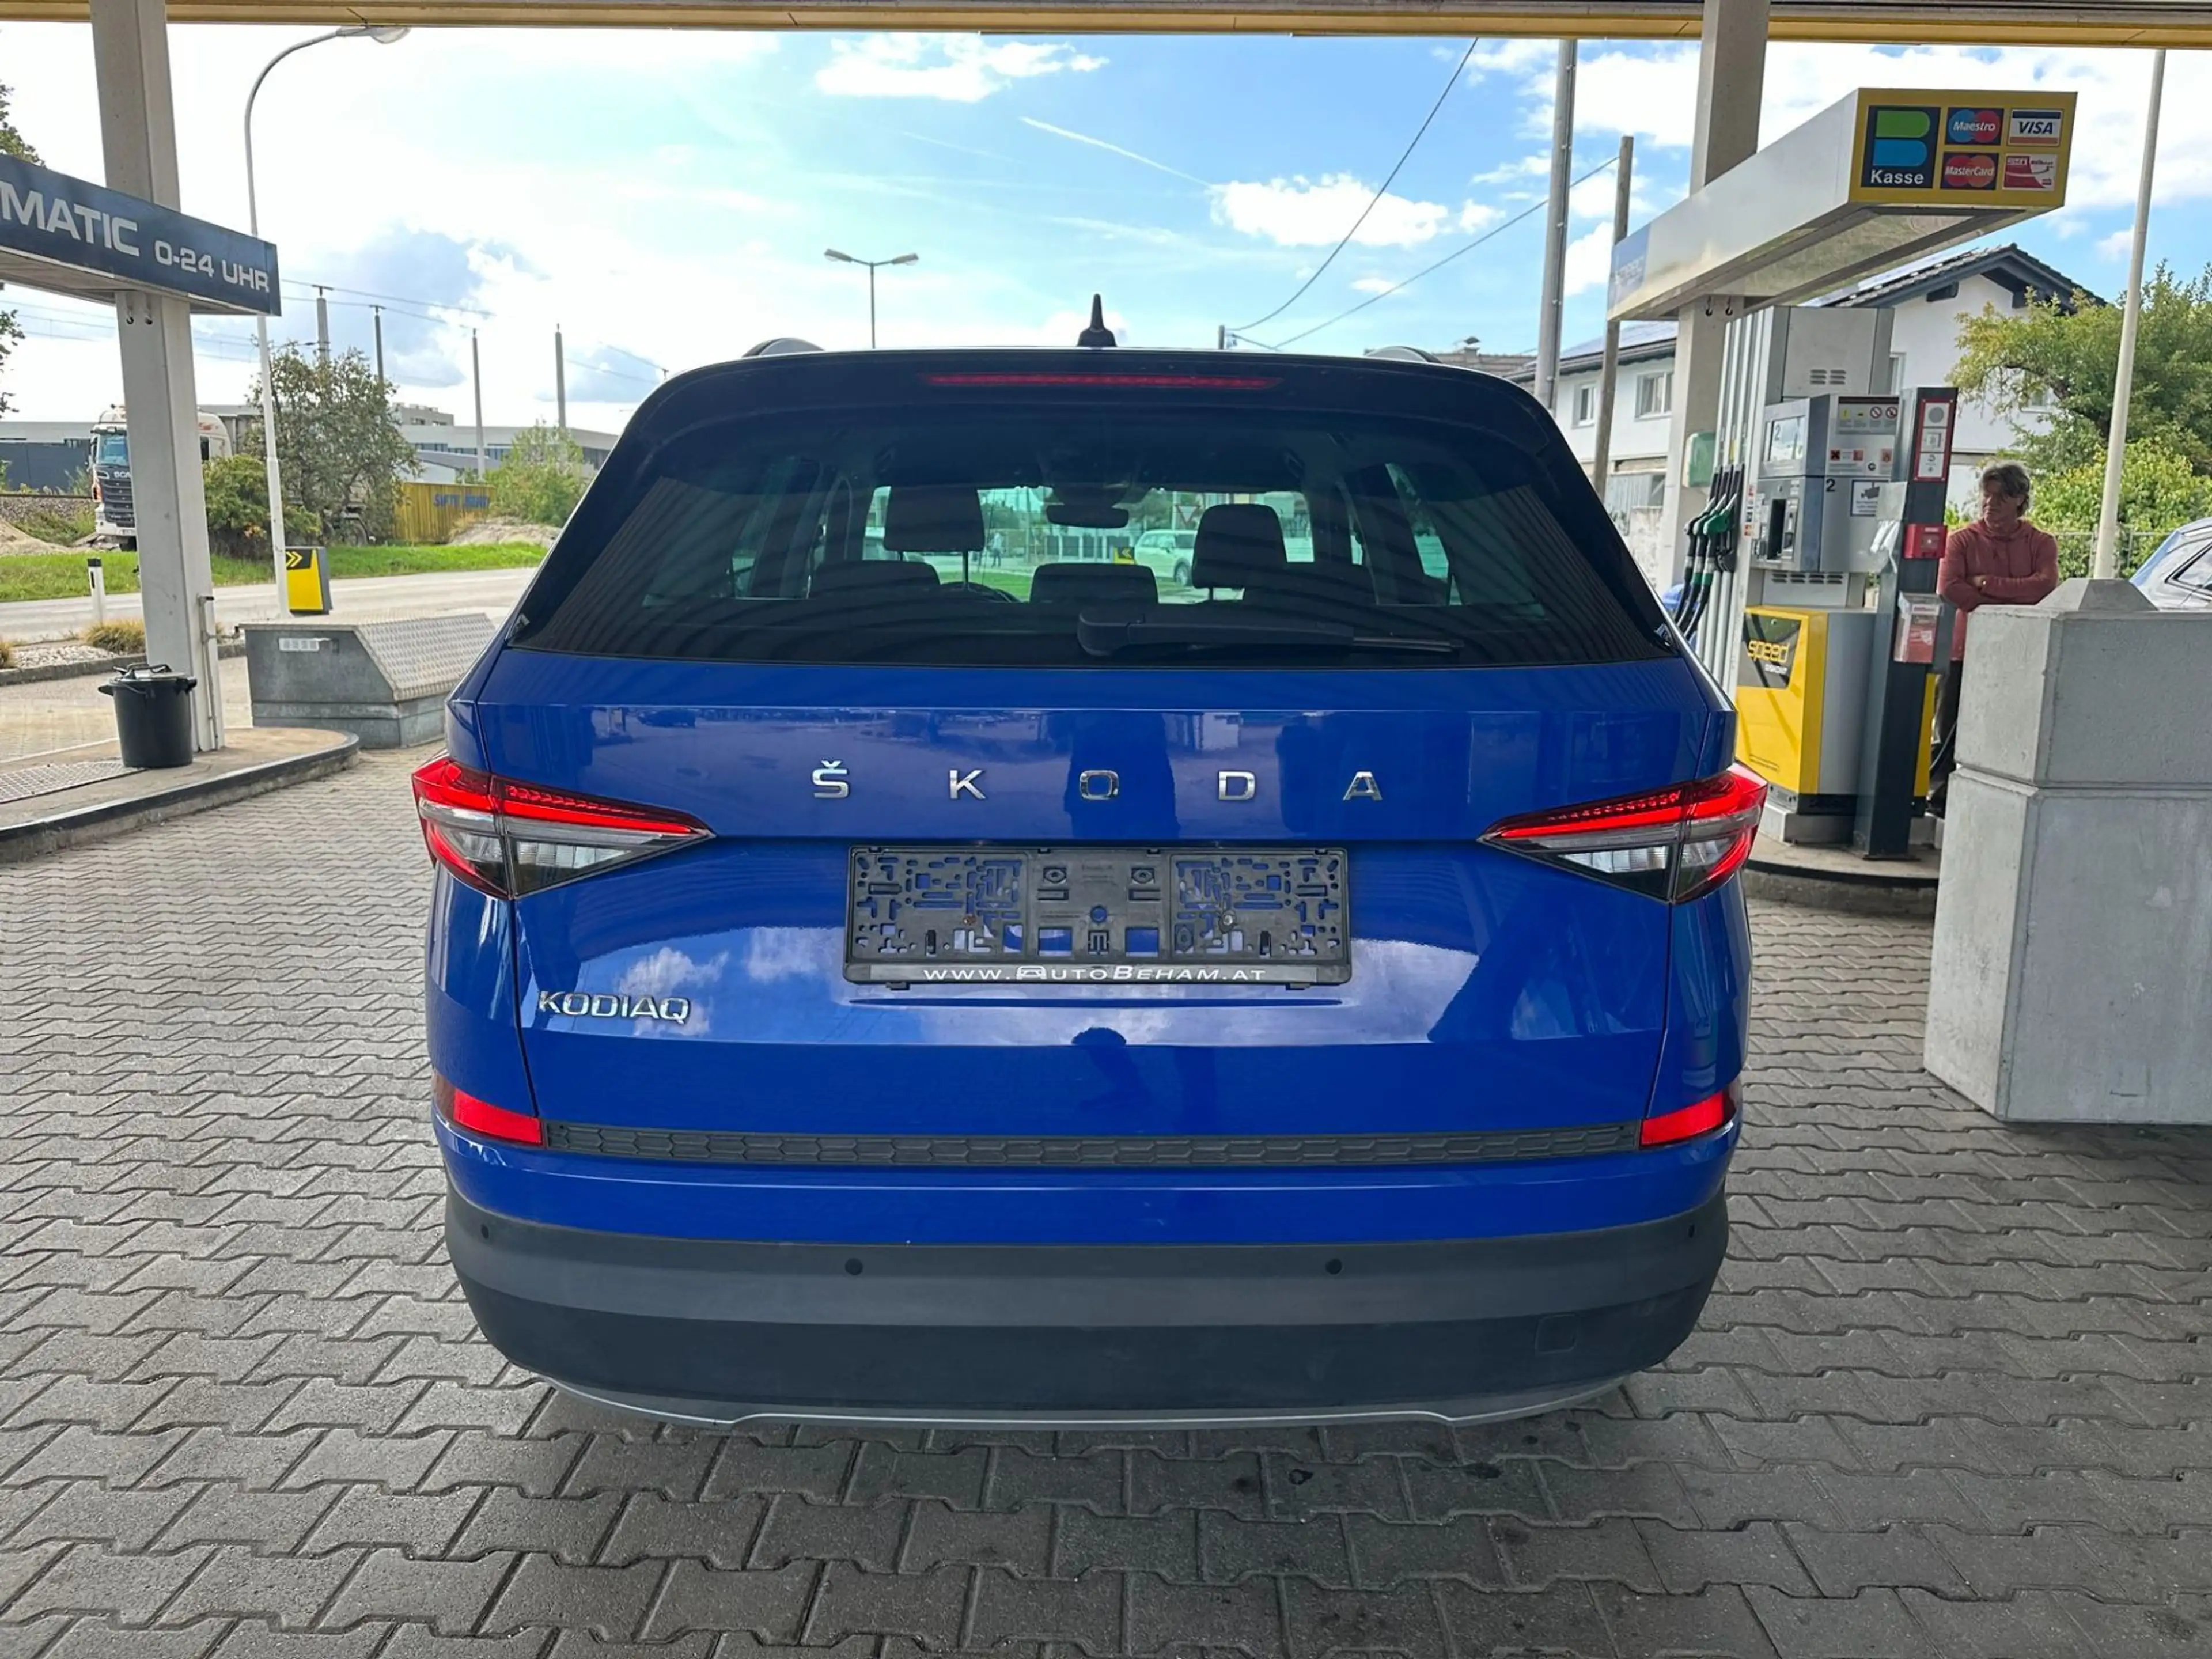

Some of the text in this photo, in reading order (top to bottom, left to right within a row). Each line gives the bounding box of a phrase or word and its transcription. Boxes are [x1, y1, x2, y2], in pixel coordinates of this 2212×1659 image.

[1952, 120, 1996, 132] Maestro
[2018, 120, 2054, 135] VISA
[1870, 169, 1925, 185] Kasse
[1944, 165, 1994, 177] MasterCard
[154, 240, 214, 278] 0-24
[222, 259, 270, 293] UHR
[1825, 478, 1836, 493] 2
[812, 760, 1383, 800] ŠKODA
[539, 990, 692, 1024] KODIAQ
